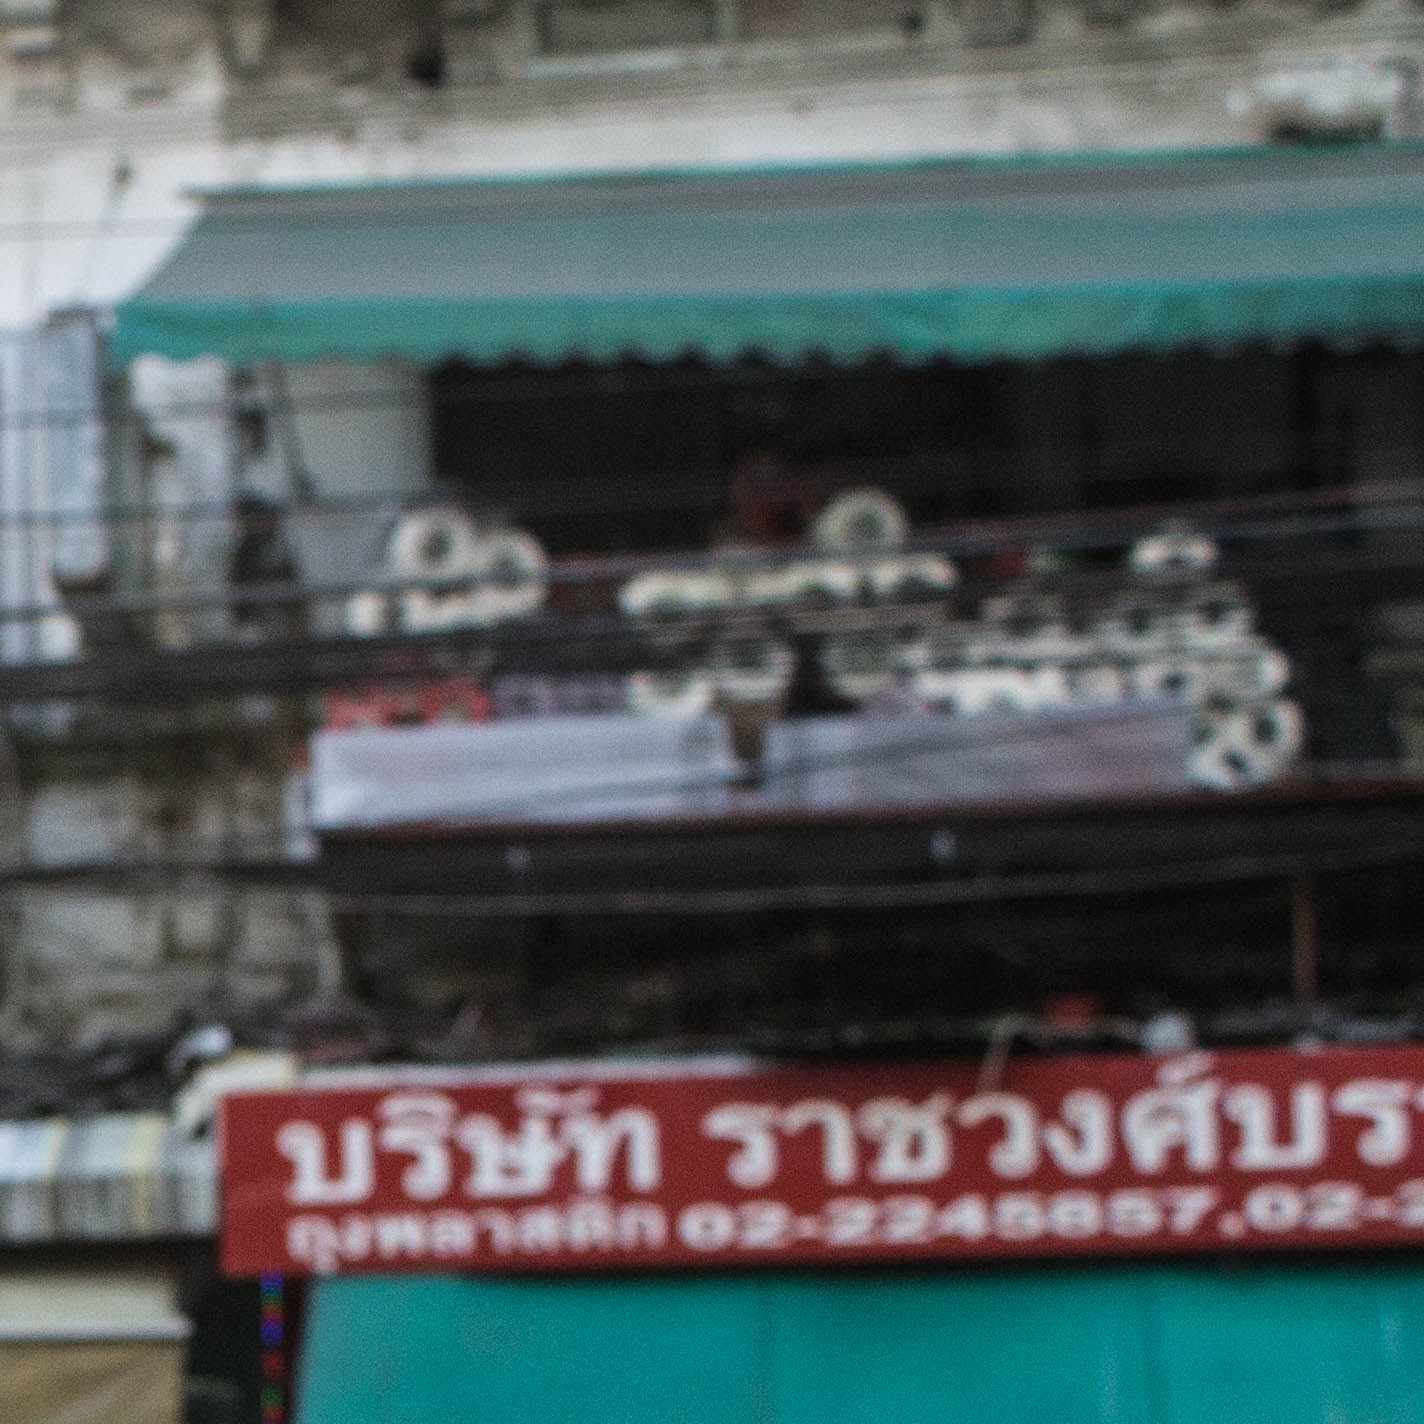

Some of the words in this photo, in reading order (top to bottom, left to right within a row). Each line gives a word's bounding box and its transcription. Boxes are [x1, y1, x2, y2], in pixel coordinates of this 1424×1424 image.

[276, 1090, 662, 1202] บริษัท
[700, 1053, 1424, 1189] ราชวงศ์บร
[287, 1201, 668, 1274] ถุงพลาสติก
